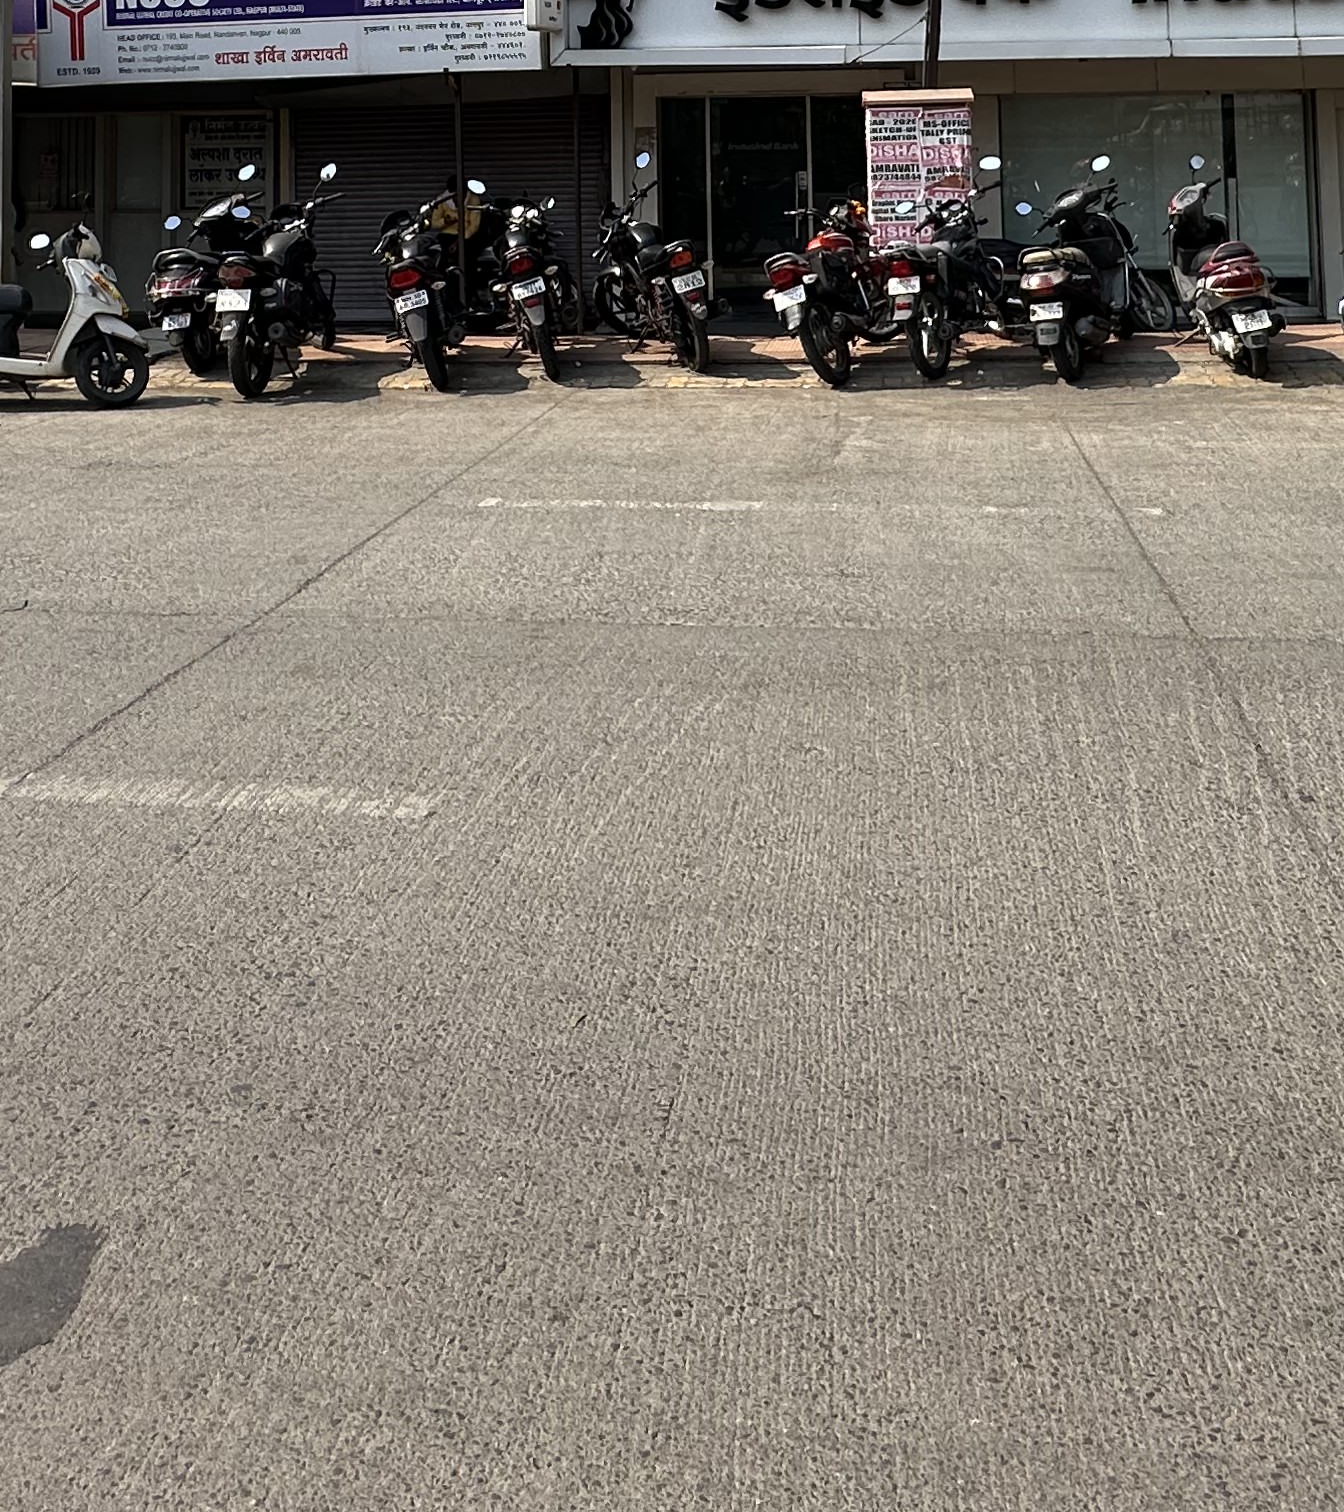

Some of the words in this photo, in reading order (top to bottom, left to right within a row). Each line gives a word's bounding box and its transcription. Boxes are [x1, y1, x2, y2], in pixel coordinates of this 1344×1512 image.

[214, 51, 249, 65] शाखा
[290, 42, 349, 63] अमरावती
[920, 129, 944, 137] TALLY
[870, 164, 920, 173] AMRAVATI
